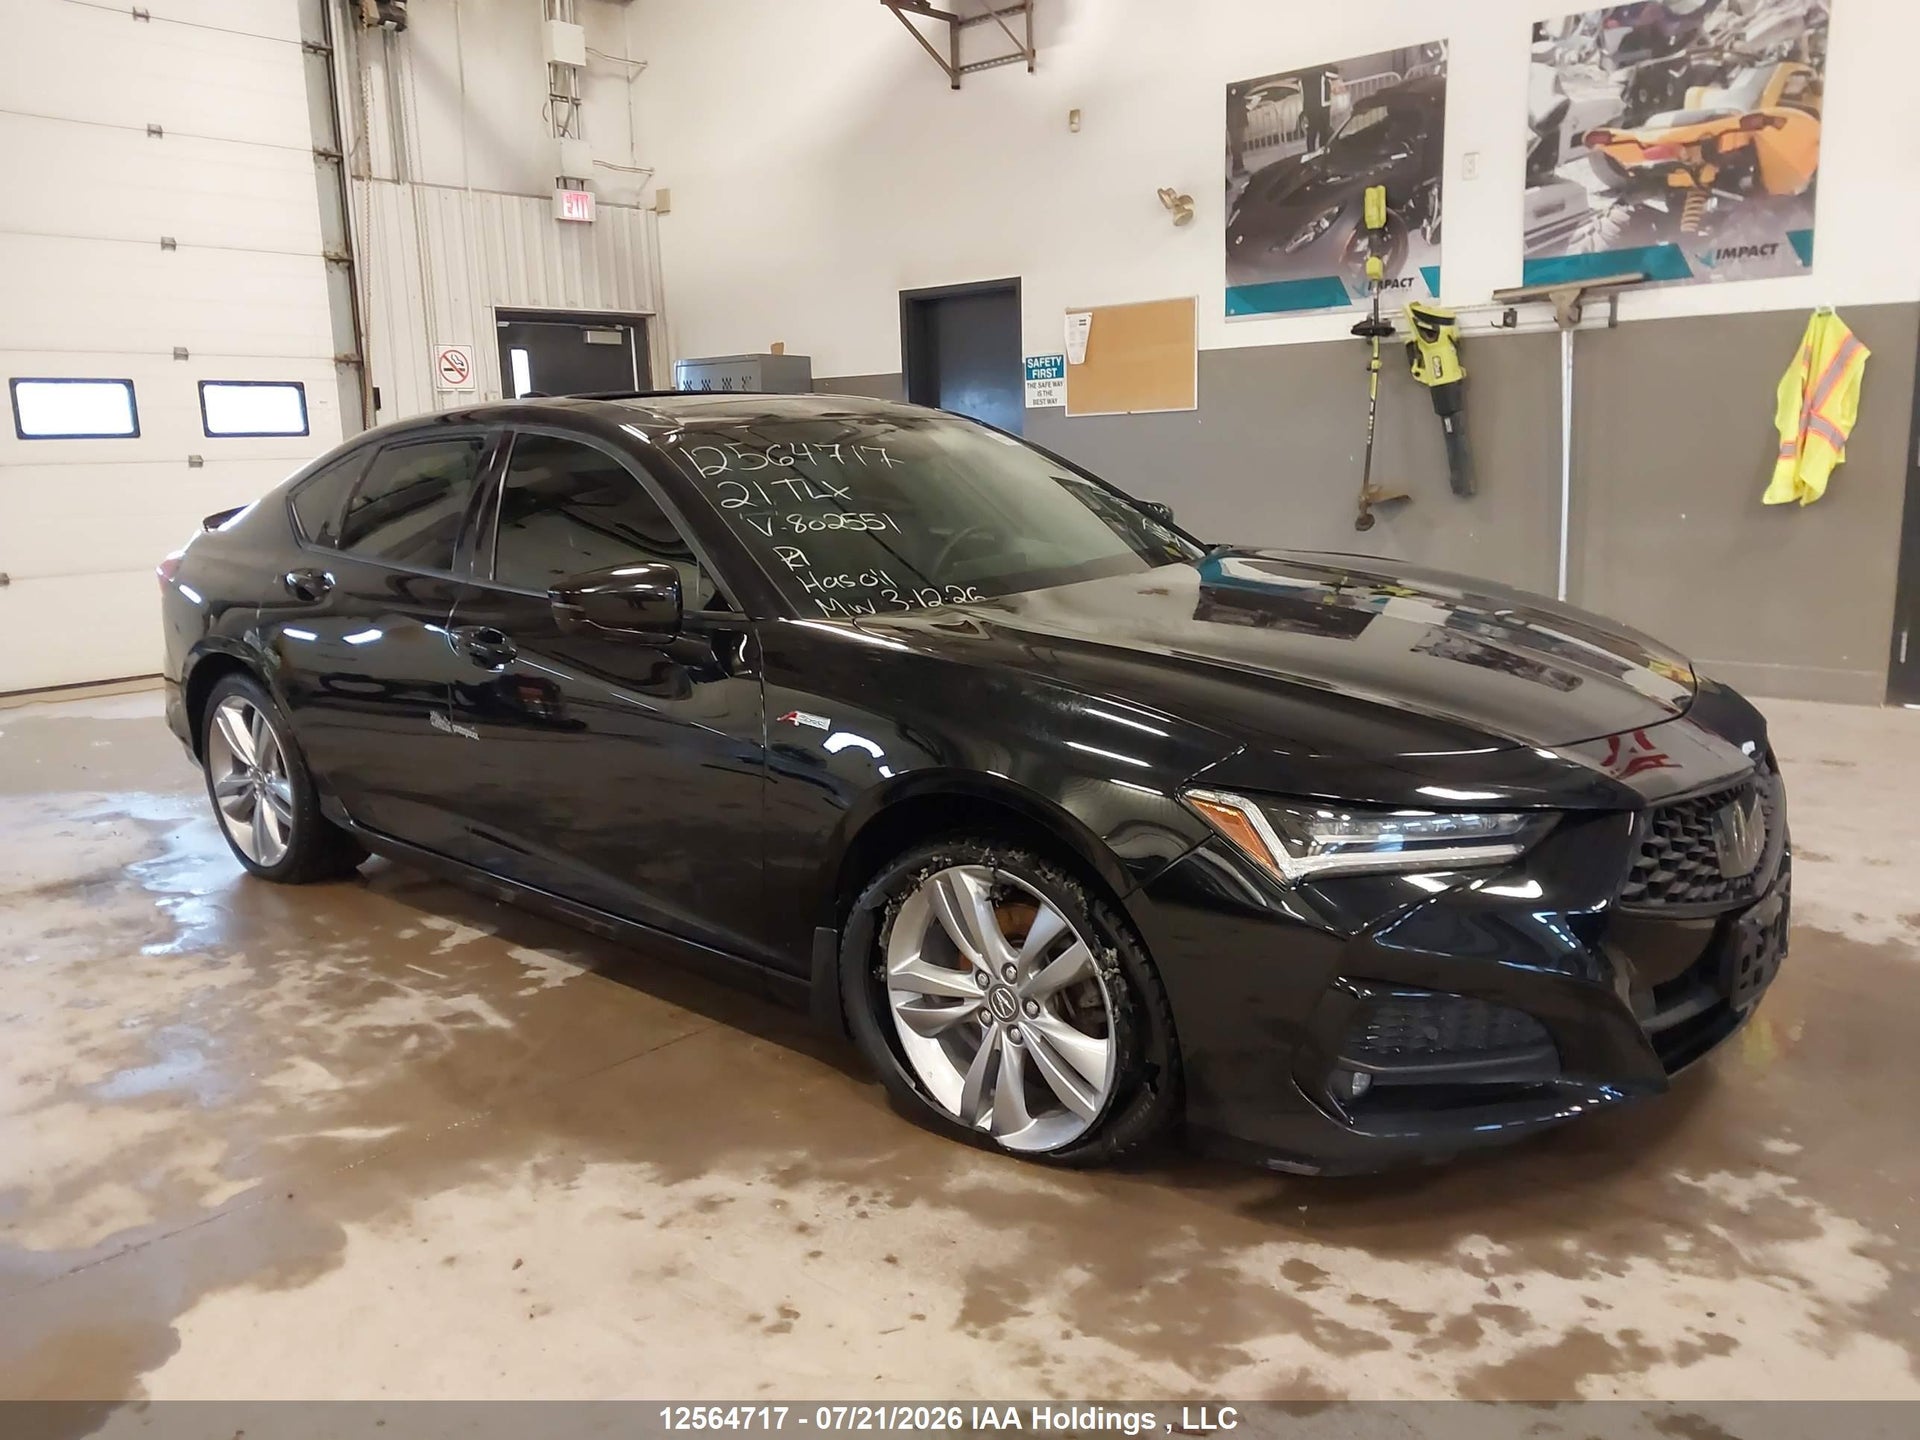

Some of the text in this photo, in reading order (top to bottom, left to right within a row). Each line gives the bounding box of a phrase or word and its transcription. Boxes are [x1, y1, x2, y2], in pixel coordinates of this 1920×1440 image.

[1716, 243, 1779, 260] IMPACT
[1027, 356, 1062, 368] SAFETY
[1032, 368, 1057, 379] FIRST
[679, 442, 905, 479] 12564717
[770, 478, 852, 502] TLX
